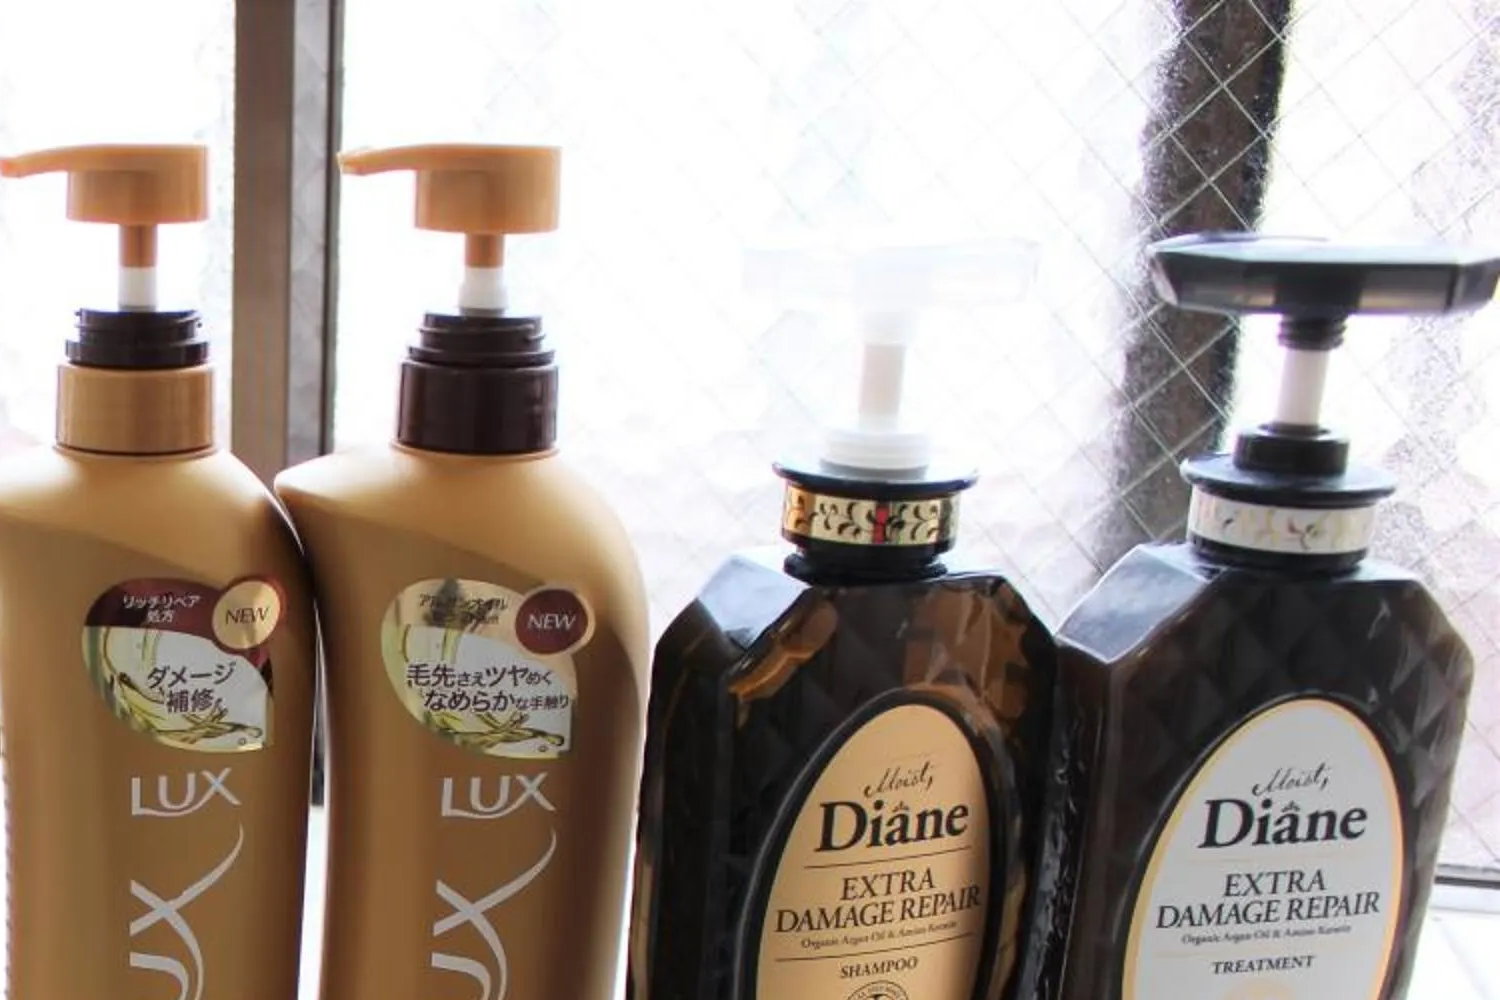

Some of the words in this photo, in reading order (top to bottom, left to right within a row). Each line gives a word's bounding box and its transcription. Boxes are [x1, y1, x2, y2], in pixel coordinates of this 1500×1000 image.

[224, 605, 270, 626] NEW
[527, 612, 578, 631] NEW
[147, 661, 237, 689] ダメージ
[407, 663, 554, 689] 毛先さえツヤめく
[166, 687, 216, 714] 補修
[423, 690, 570, 713] なめらかな手触り
[131, 766, 242, 817] LUX
[441, 771, 558, 820] LUX
[839, 866, 936, 902] EXTRA
[1223, 867, 1327, 898] EXTRA
[774, 899, 895, 933] DAMAGE
[900, 884, 983, 921] REPAIR
[1155, 898, 1282, 929] DAMAGE
[1286, 890, 1381, 920] REPAIR
[1181, 933, 1221, 946] Organic
[839, 955, 920, 979] SHAMPOO
[1211, 954, 1316, 975] TREATMENT
